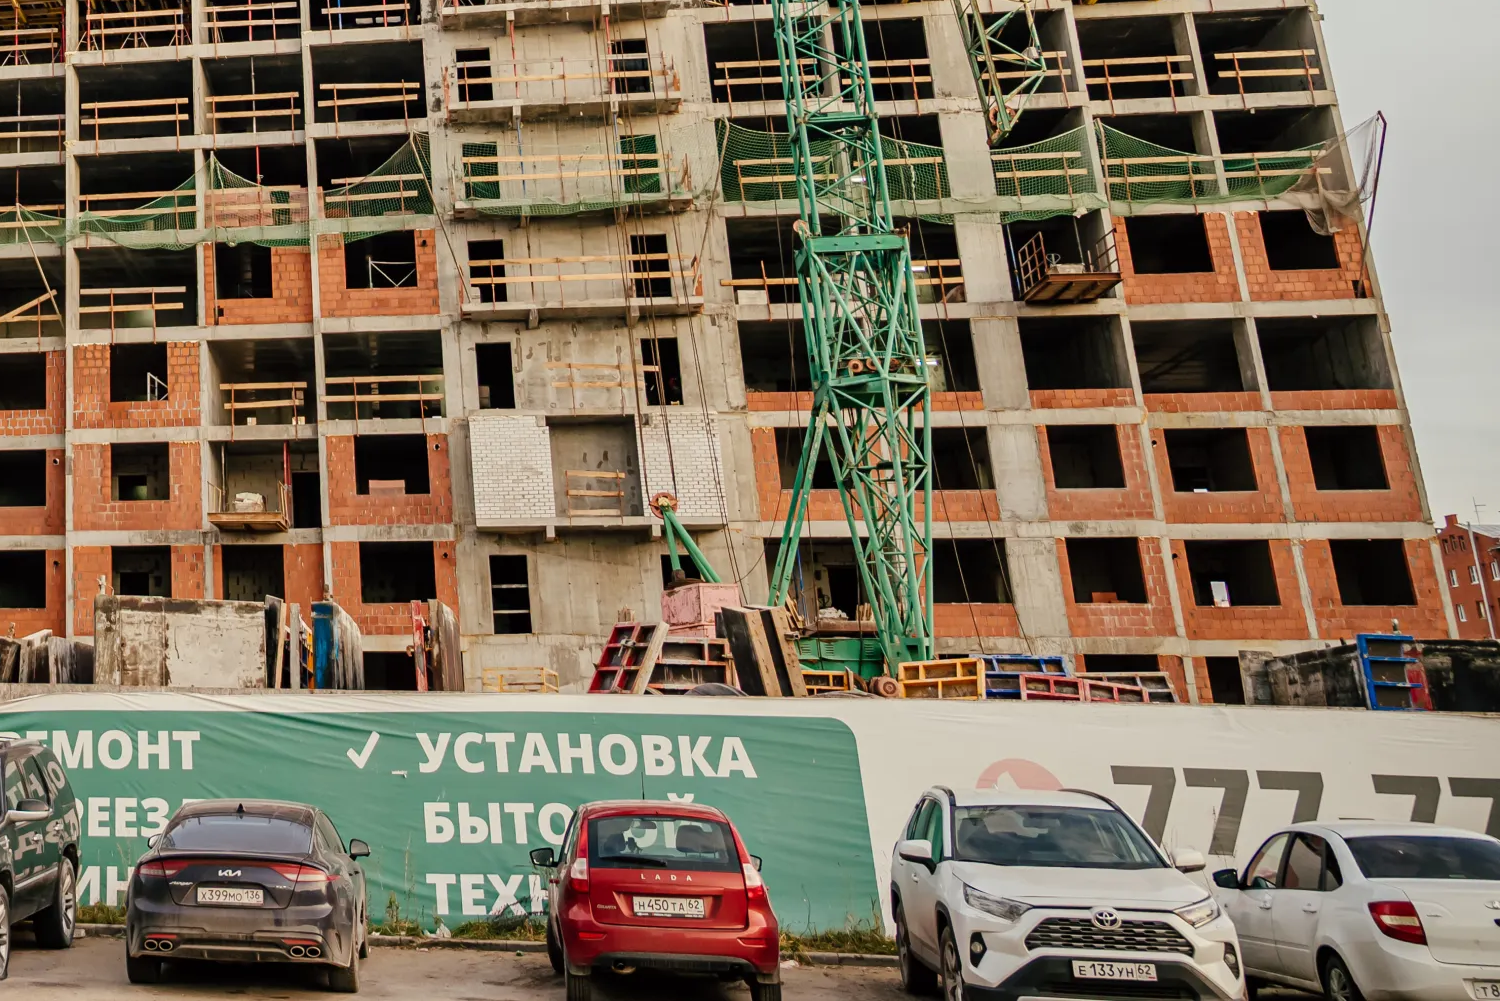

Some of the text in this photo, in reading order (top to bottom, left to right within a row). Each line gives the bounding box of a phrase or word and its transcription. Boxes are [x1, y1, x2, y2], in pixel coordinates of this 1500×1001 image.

[416, 732, 758, 778] УСТАНОВКА
[640, 873, 693, 882] LADA
[244, 890, 261, 900] 136
[688, 899, 700, 910] 62
[1137, 964, 1152, 975] 62
